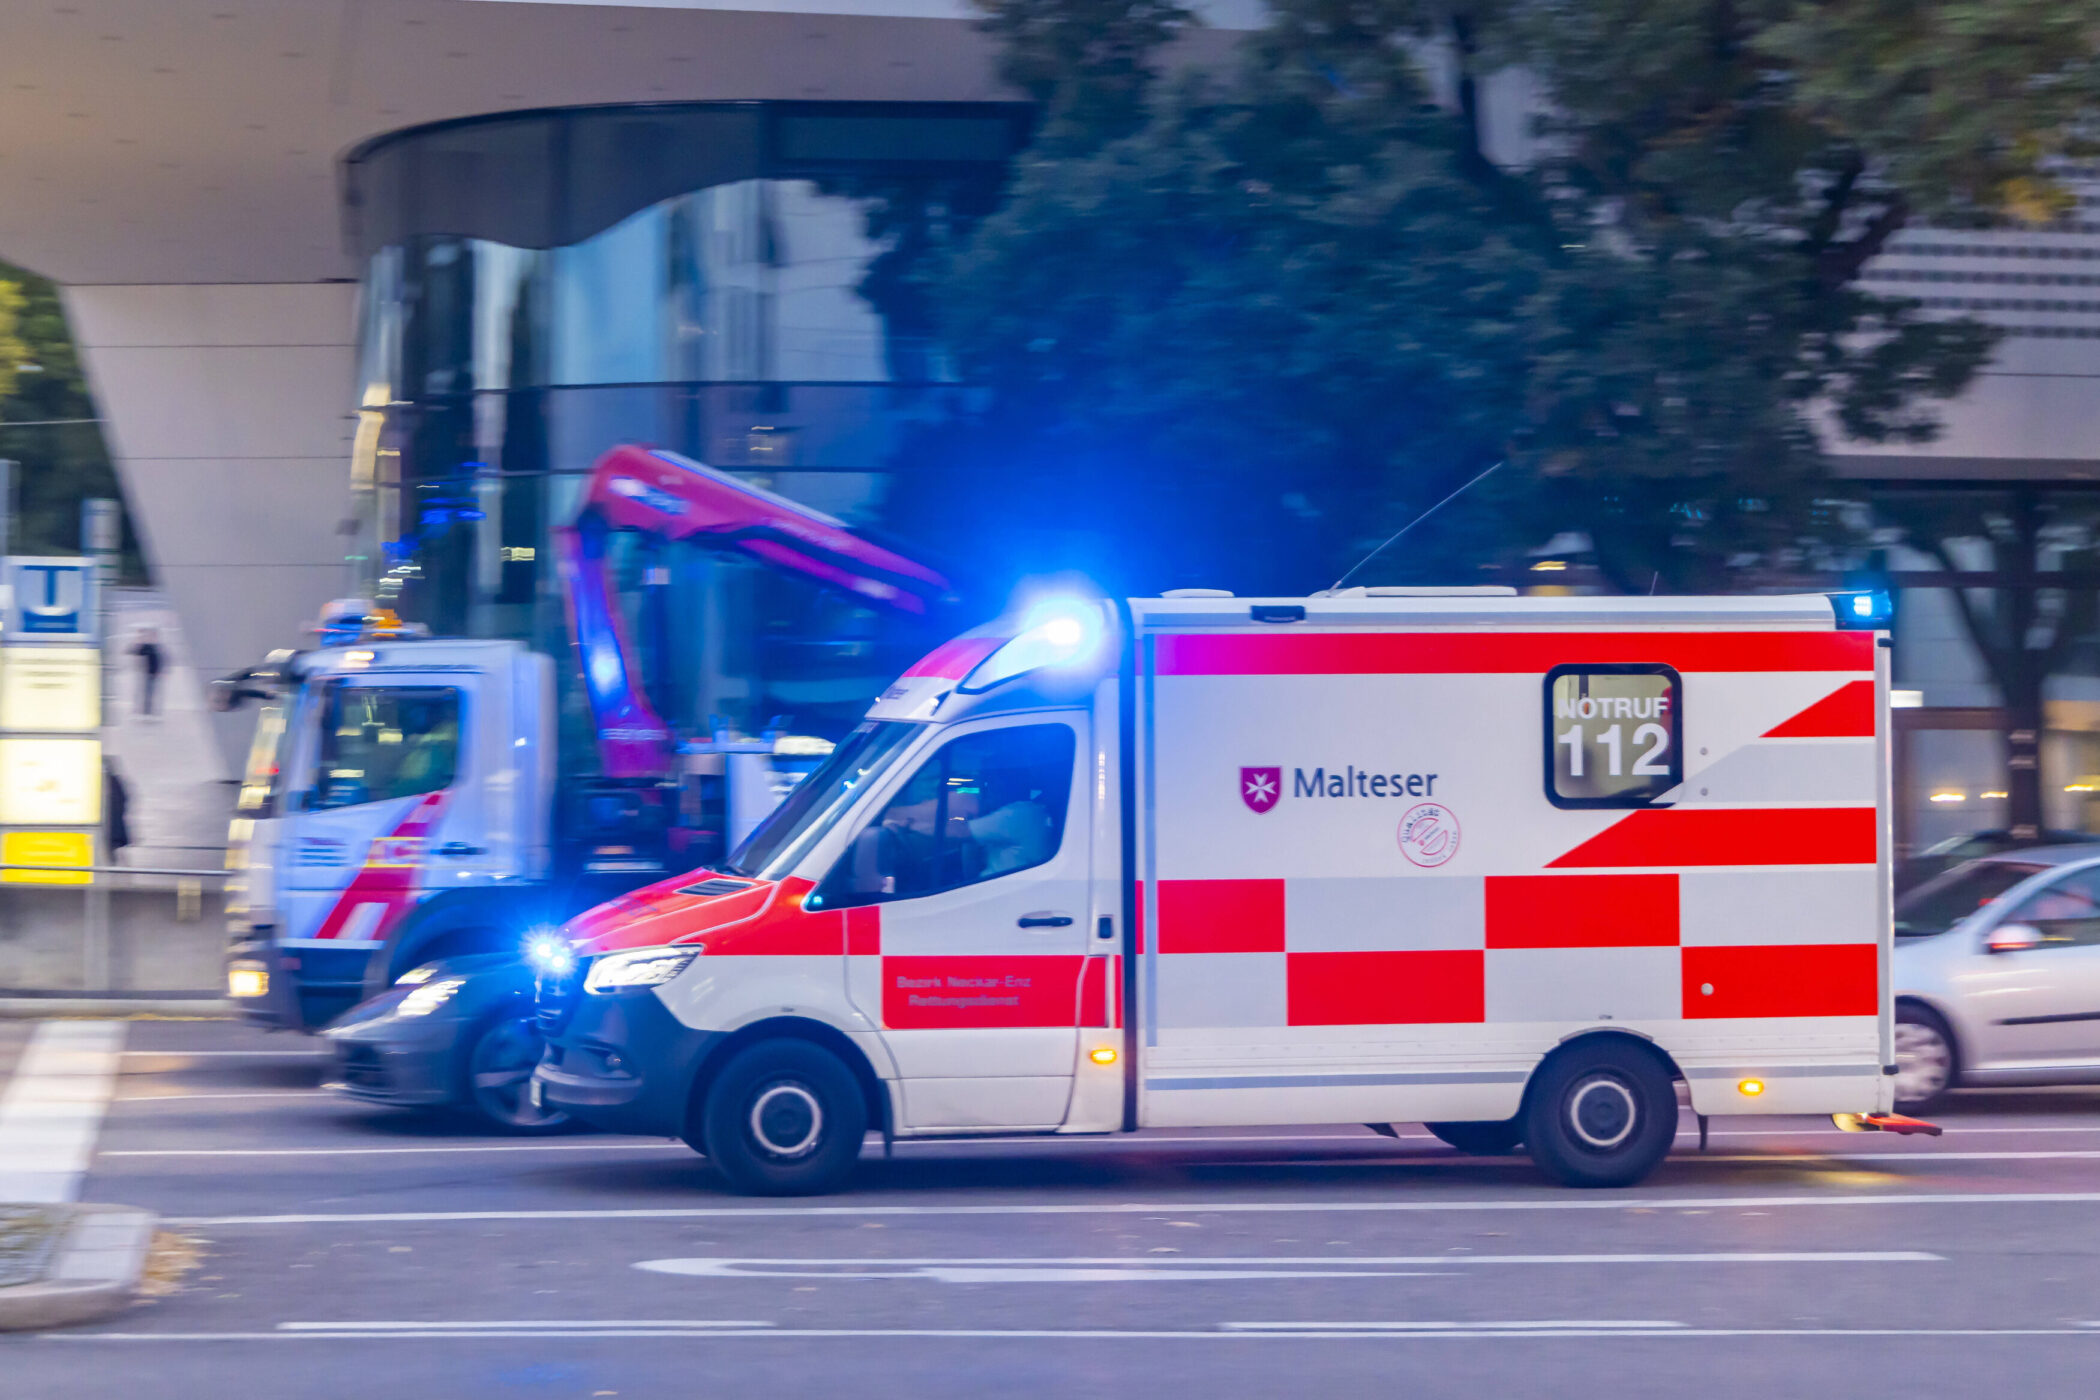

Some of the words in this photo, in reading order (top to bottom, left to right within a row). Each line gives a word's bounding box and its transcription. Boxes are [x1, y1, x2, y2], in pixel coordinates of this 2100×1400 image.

[1557, 697, 1669, 719] NOTRUF
[1558, 723, 1670, 776] 112
[1294, 765, 1438, 797] Malteser
[897, 976, 942, 988] Bezirk
[947, 975, 1032, 987] Neckar-Enz
[908, 994, 1019, 1008] Rettungsdienst
